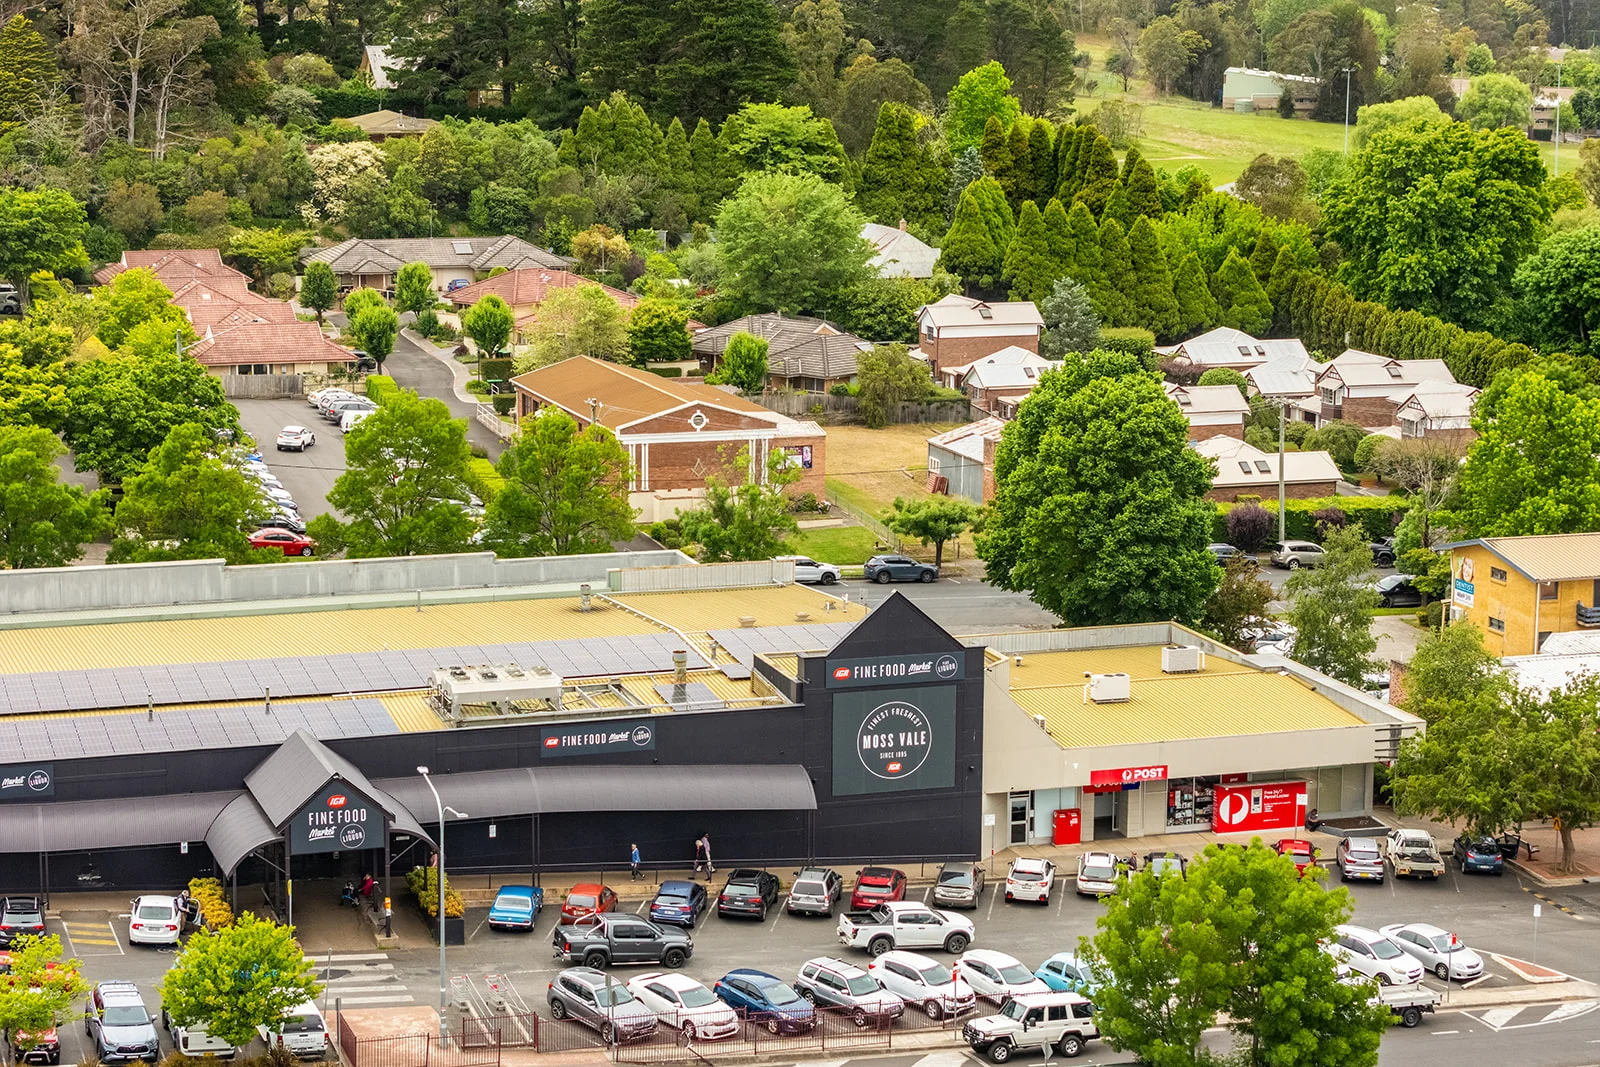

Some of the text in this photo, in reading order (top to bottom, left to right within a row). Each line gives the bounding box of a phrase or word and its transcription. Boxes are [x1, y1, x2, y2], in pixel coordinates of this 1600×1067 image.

[834, 661, 933, 679] IGA FINE FOOD Market
[937, 663, 956, 673] LIQUOR
[867, 707, 923, 731] FINEST FRESHEST
[545, 731, 630, 747] IGA FINE FOOD Market
[862, 730, 926, 749] MOSS VALE
[879, 751, 894, 759] SINCE
[887, 763, 901, 771] IGA
[1133, 767, 1164, 779] POST
[1, 775, 26, 787] Market
[329, 796, 346, 807] IGA
[308, 808, 367, 826] FINE FOOD
[308, 826, 337, 839] Market
[342, 831, 363, 843] LIQUOR
